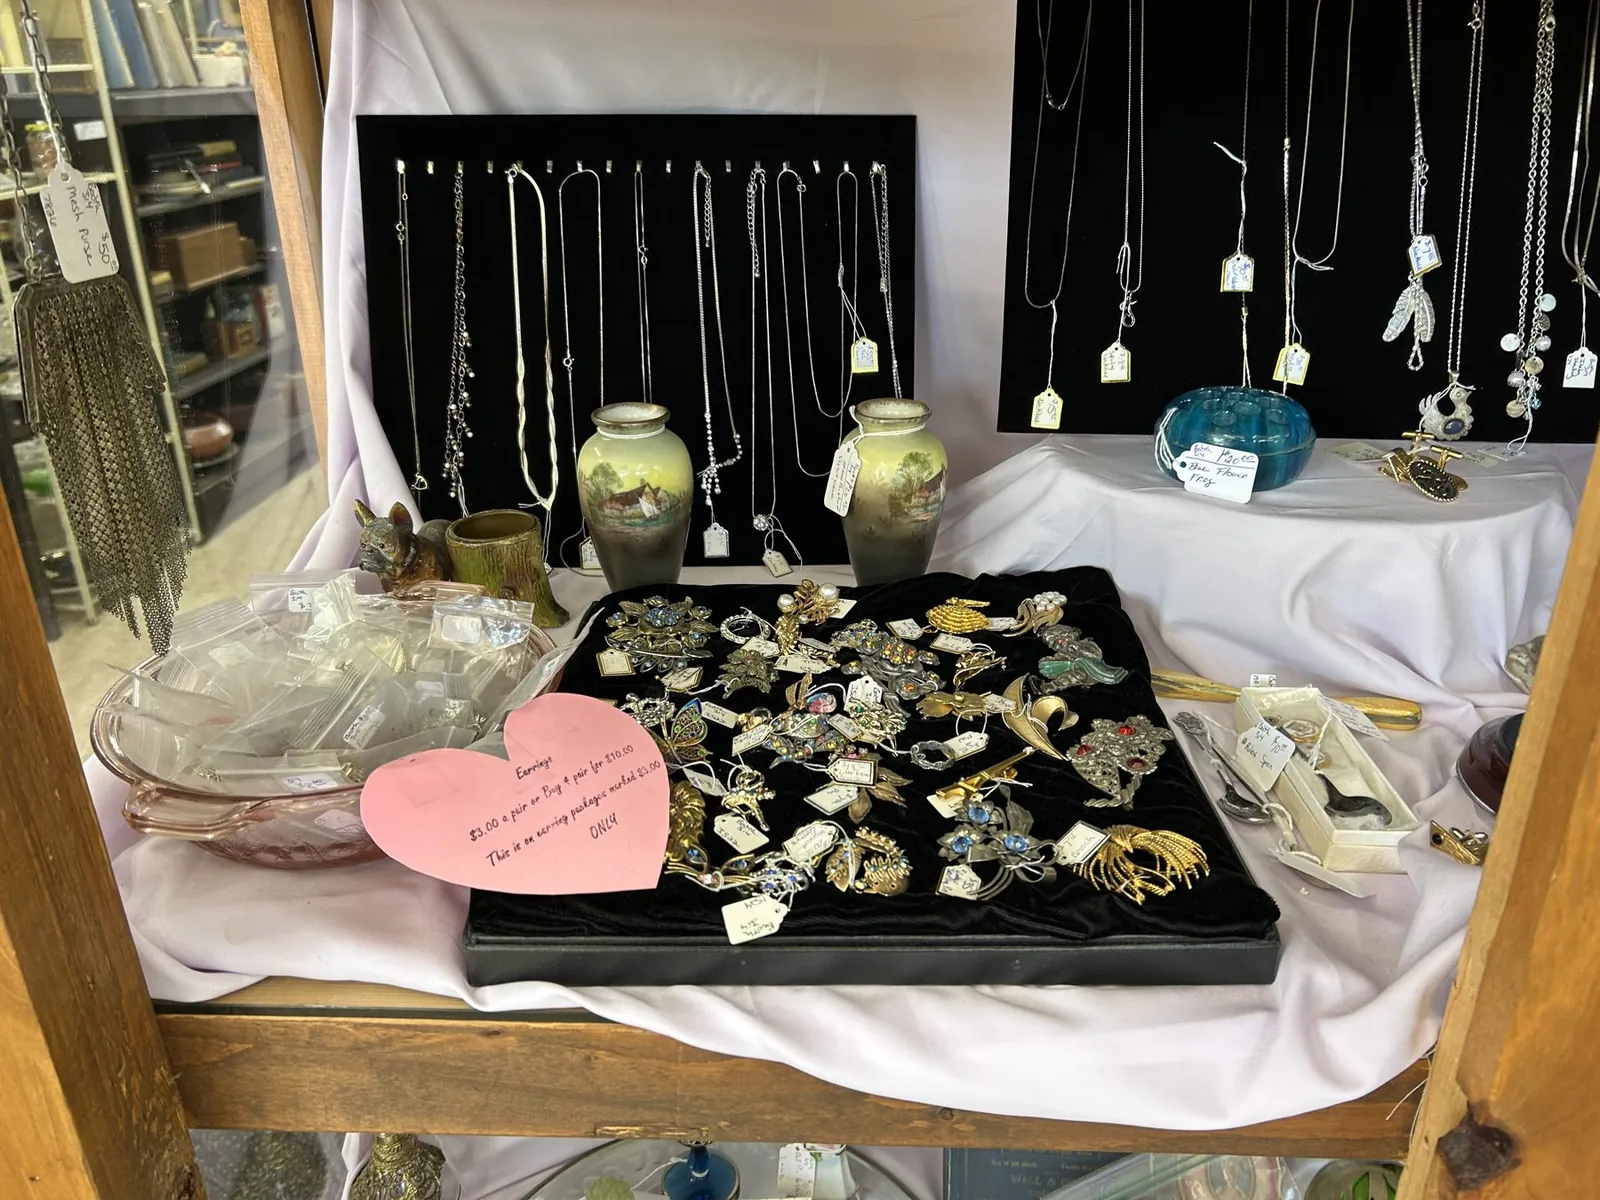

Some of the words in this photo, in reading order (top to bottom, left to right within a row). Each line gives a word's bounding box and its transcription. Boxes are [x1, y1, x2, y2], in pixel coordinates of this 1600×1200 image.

[67, 186, 84, 222] Mesh
[79, 228, 92, 267] Purse
[469, 820, 499, 842] $3.00
[510, 804, 528, 822] pair
[531, 797, 540, 806] or
[541, 784, 563, 800] Buy
[573, 768, 589, 785] pair
[591, 760, 604, 774] for
[605, 744, 634, 764] $10.00
[515, 755, 553, 780] Earrings
[486, 849, 510, 867] This
[513, 842, 522, 852] is
[537, 815, 569, 838] earring
[570, 790, 608, 821] packages
[609, 771, 638, 794] marked
[637, 760, 661, 778] $3.00
[589, 812, 619, 839] ONLY
